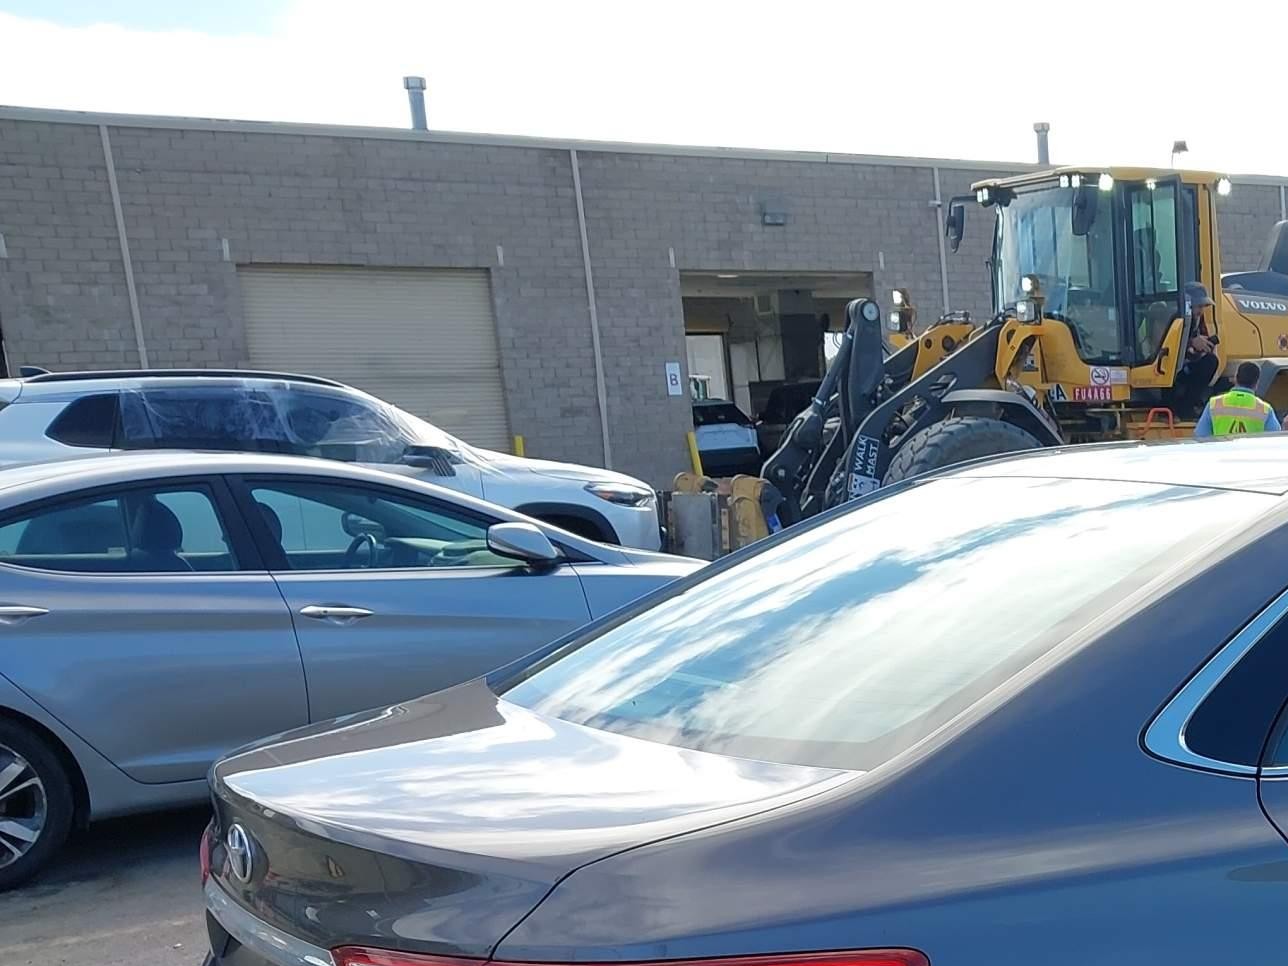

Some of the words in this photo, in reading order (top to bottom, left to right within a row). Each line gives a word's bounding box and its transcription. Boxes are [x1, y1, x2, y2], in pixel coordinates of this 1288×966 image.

[1239, 300, 1287, 311] VOLVO
[670, 374, 679, 386] B
[854, 436, 868, 471] WALK
[866, 443, 878, 475] MAST
